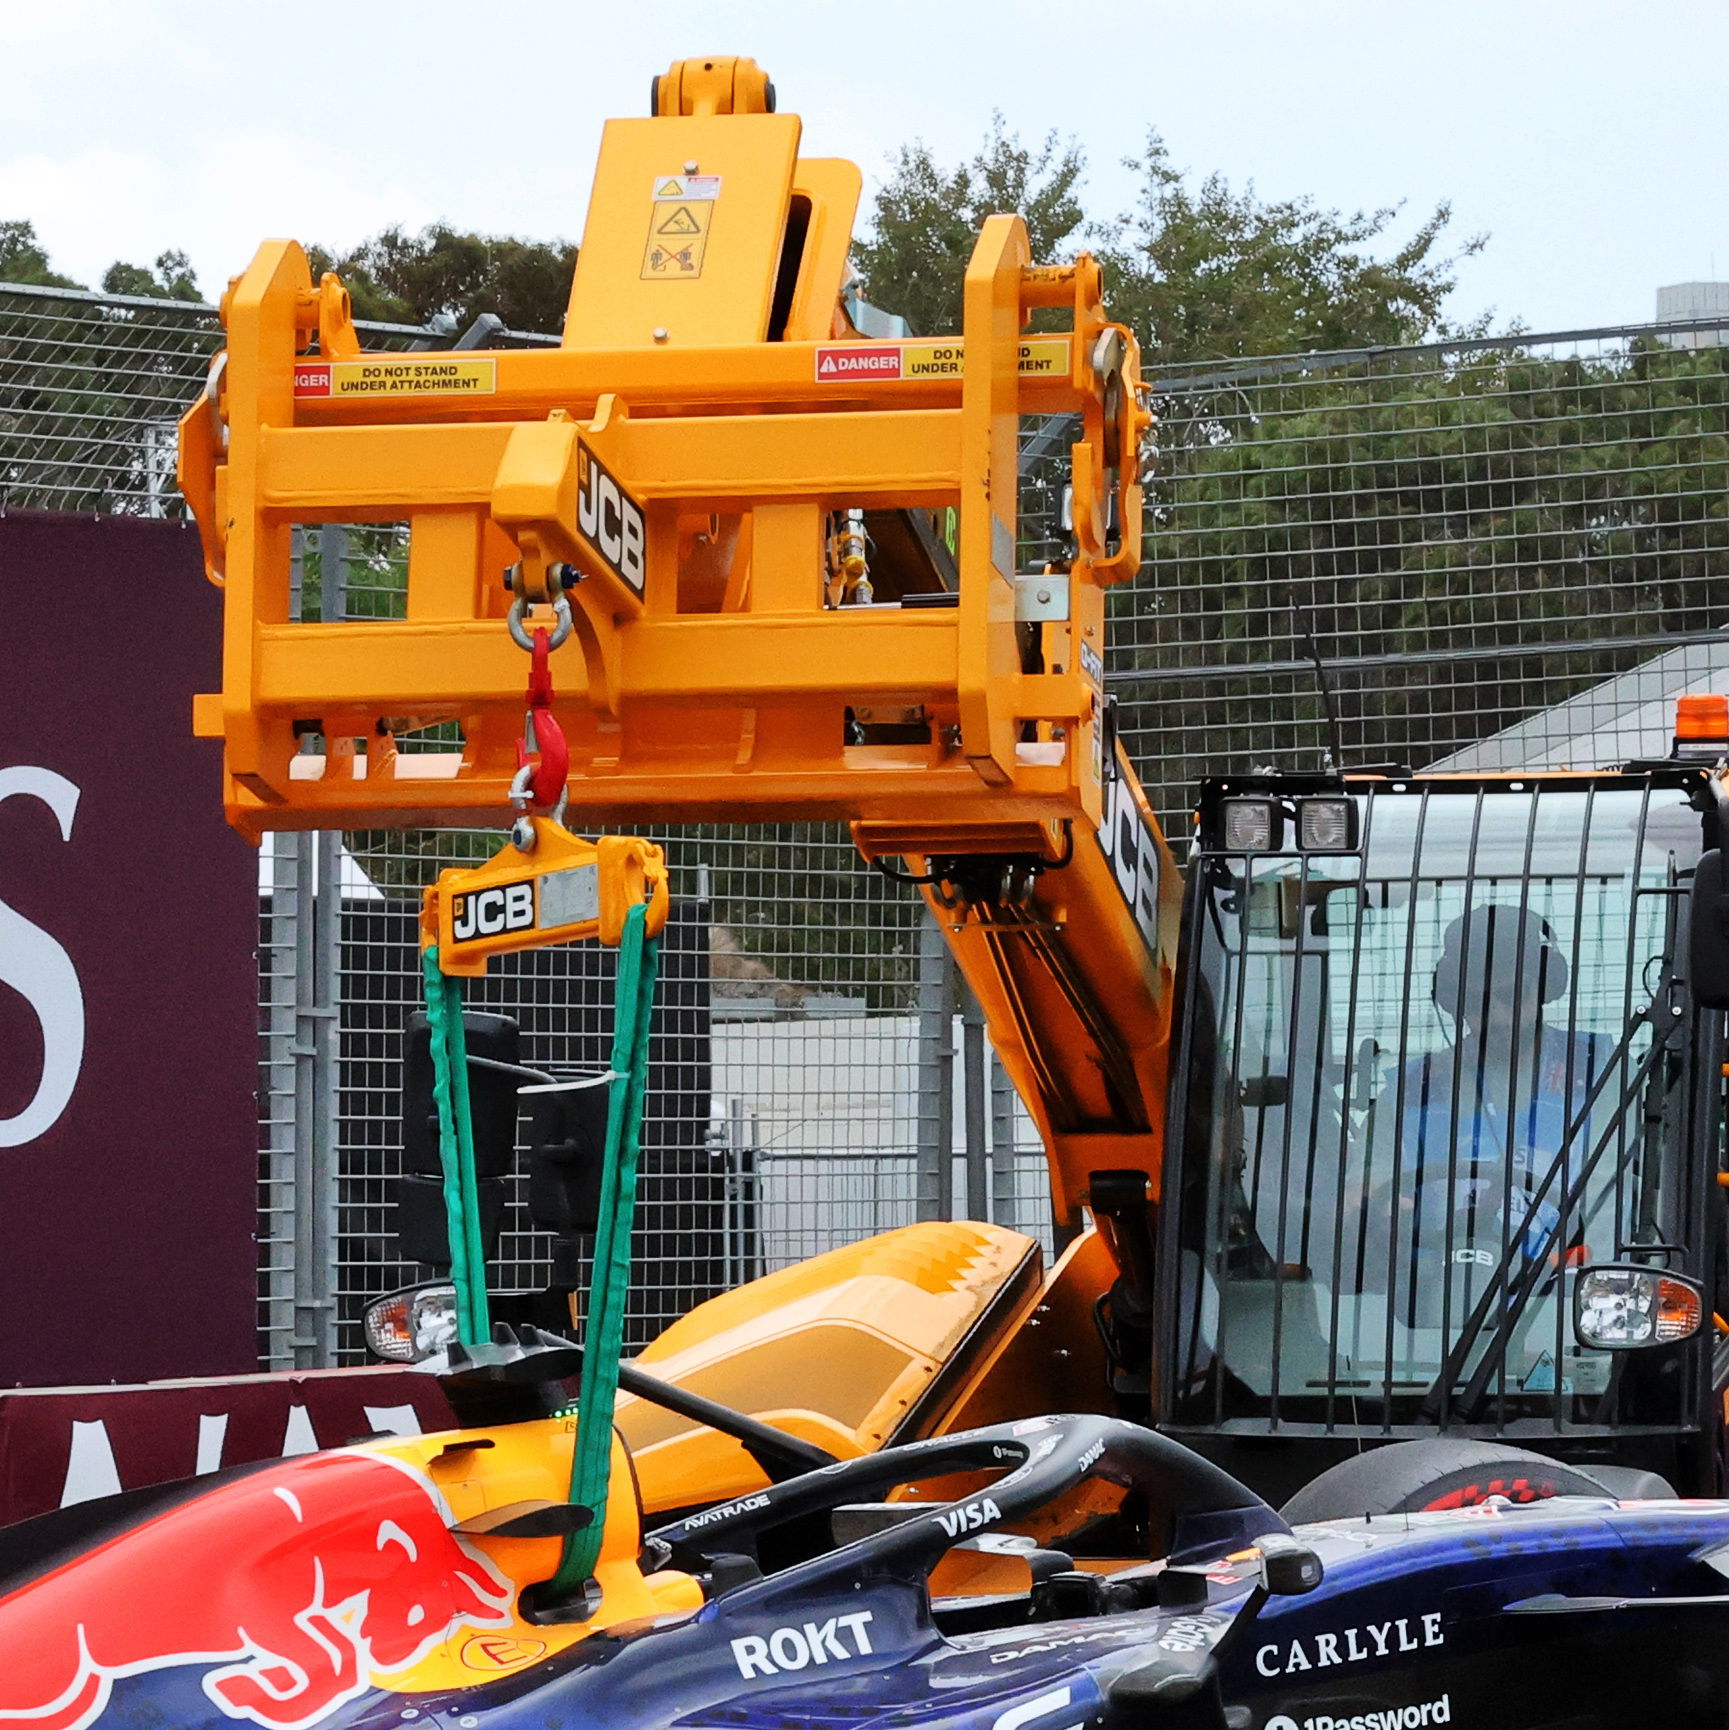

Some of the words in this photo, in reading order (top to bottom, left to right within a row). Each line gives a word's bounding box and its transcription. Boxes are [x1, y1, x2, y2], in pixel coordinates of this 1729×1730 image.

[294, 374, 329, 388] GER
[362, 367, 381, 378] DO
[384, 366, 410, 378] NOT
[414, 365, 458, 377] STAND
[837, 355, 900, 372] DANGER
[911, 362, 959, 375] UNDER
[340, 379, 386, 392] UNDER
[390, 377, 479, 391] ATTACHMENT
[578, 460, 645, 591] JCB
[1098, 778, 1159, 951] JCB
[453, 883, 535, 940] JCB
[1442, 1249, 1494, 1267] CB
[684, 1494, 772, 1531] AVATRADE
[930, 1498, 1002, 1538] VISA
[730, 1610, 875, 1681] ROKT
[1255, 1611, 1445, 1678] CARLYLE
